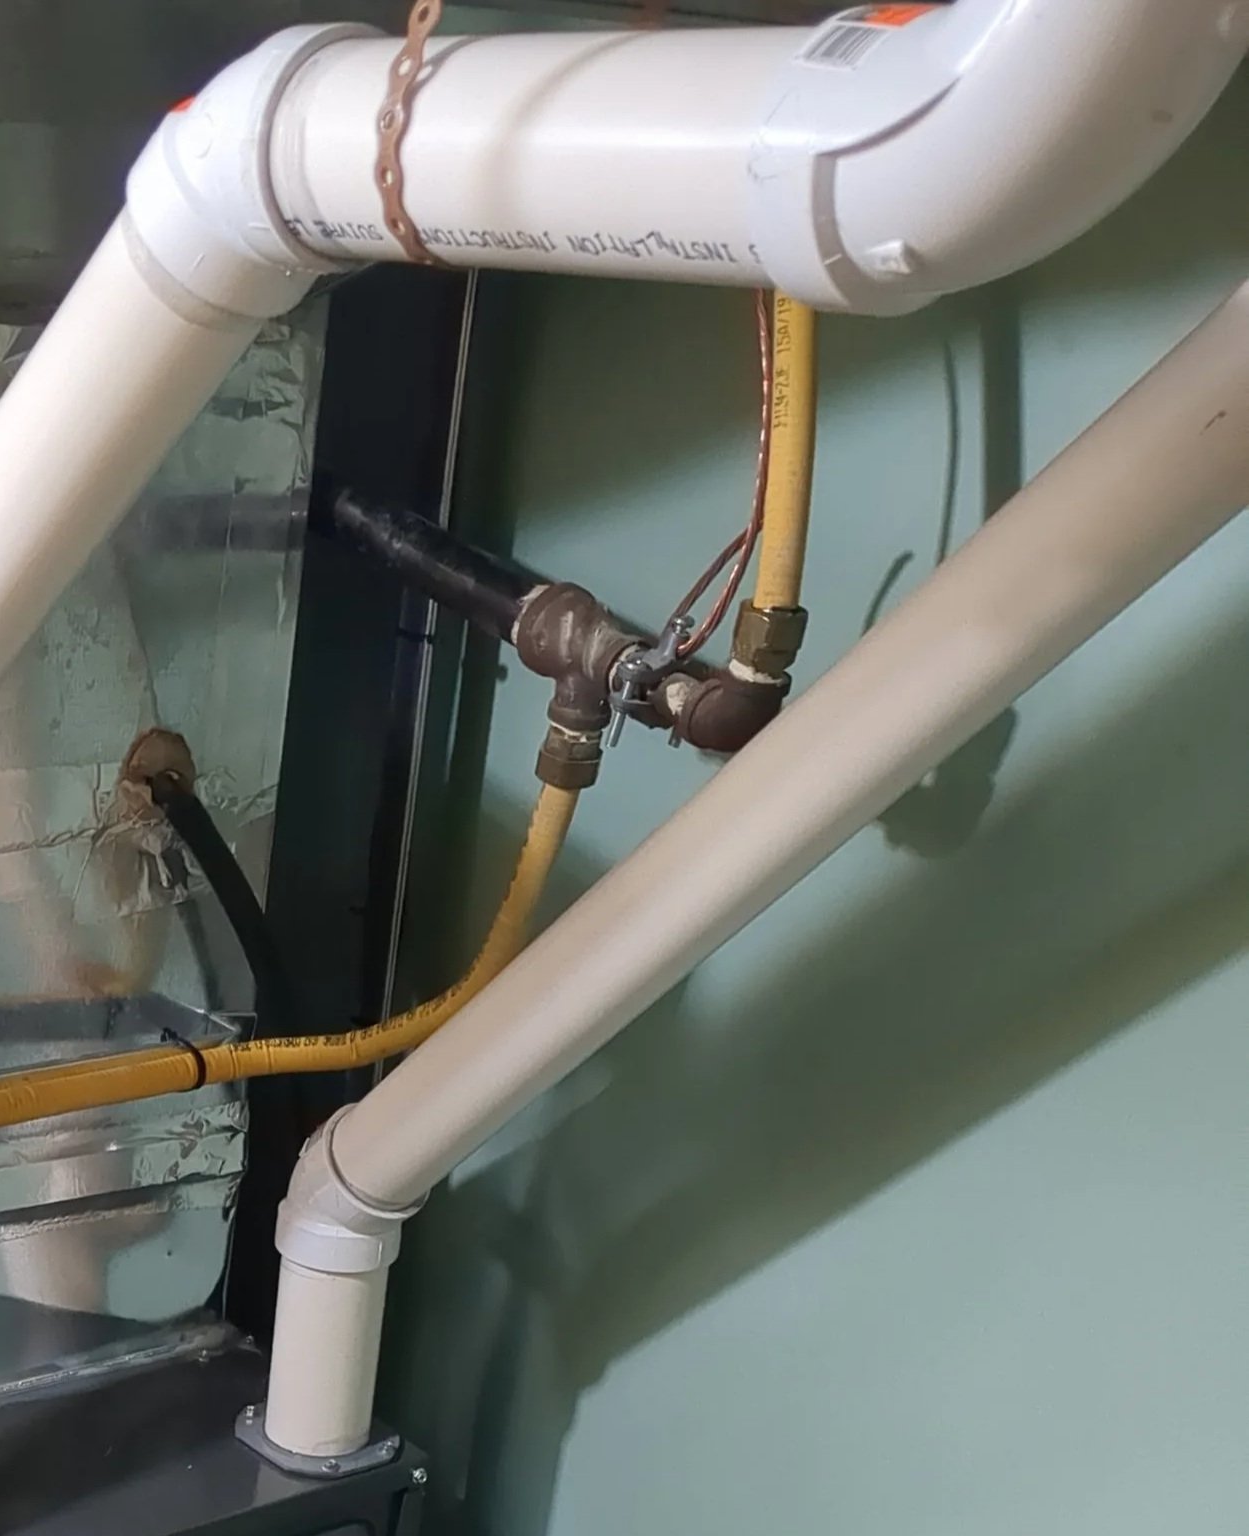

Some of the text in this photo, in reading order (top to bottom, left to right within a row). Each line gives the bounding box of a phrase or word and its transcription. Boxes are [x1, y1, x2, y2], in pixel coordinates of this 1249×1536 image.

[313, 220, 384, 241] SUIVRE
[421, 226, 557, 253] INSTRUCTION
[565, 230, 738, 262] INSTALLATION
